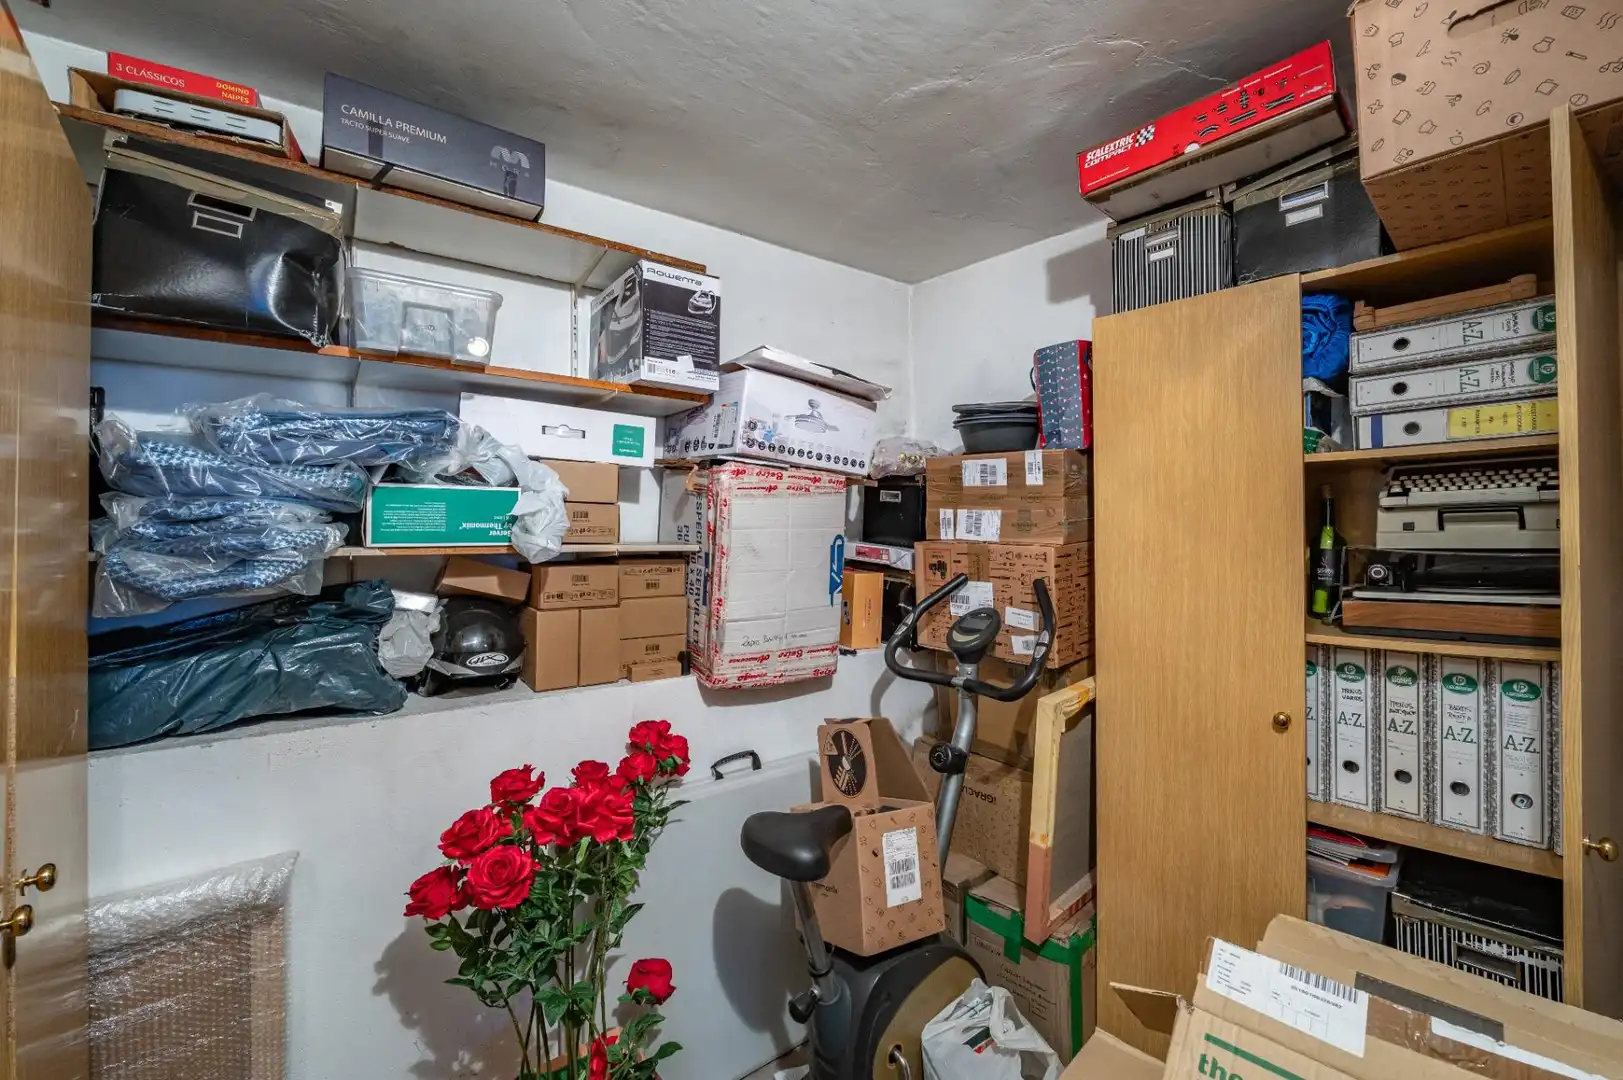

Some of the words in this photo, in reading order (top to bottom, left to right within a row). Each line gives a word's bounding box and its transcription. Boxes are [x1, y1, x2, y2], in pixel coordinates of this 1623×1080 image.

[115, 62, 123, 72] 3
[221, 91, 250, 104] NAIPES
[340, 104, 393, 128] CAMILLA
[395, 120, 448, 145] PREMIUM
[340, 118, 365, 130] TACTO
[365, 124, 388, 137] SUPER
[388, 131, 411, 144] SUAVE
[1085, 132, 1135, 162] SCALEXTRIC
